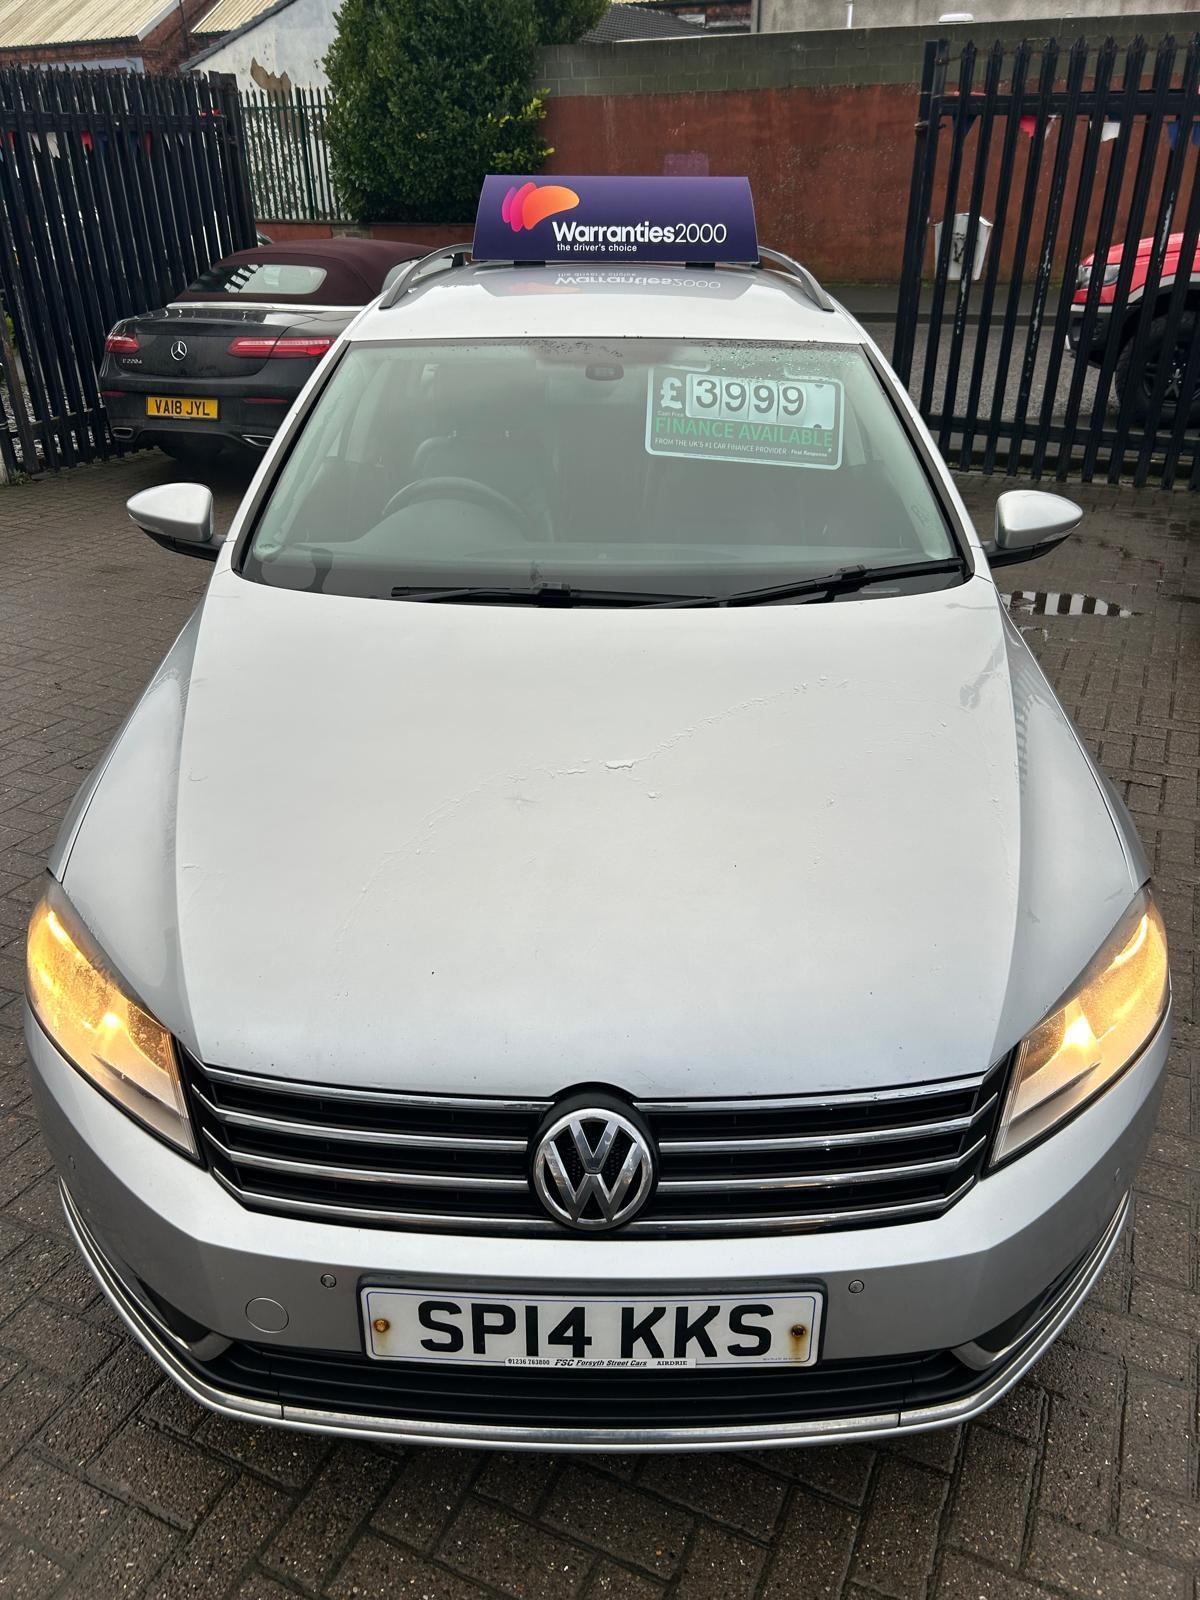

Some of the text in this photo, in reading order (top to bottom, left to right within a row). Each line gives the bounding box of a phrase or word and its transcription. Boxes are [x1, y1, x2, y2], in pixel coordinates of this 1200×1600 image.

[552, 221, 727, 243] Warranties2000
[557, 243, 637, 252] the driver's choice
[155, 400, 210, 416] VA18 JYL
[655, 416, 833, 448] FINANCE AVAILABLE
[654, 437, 674, 446] FROM
[675, 439, 687, 447] THE
[688, 440, 704, 448] UK'S
[727, 443, 754, 452] FINANCE
[755, 446, 788, 455] PROVIDER
[418, 1300, 774, 1358] SP14 KKS
